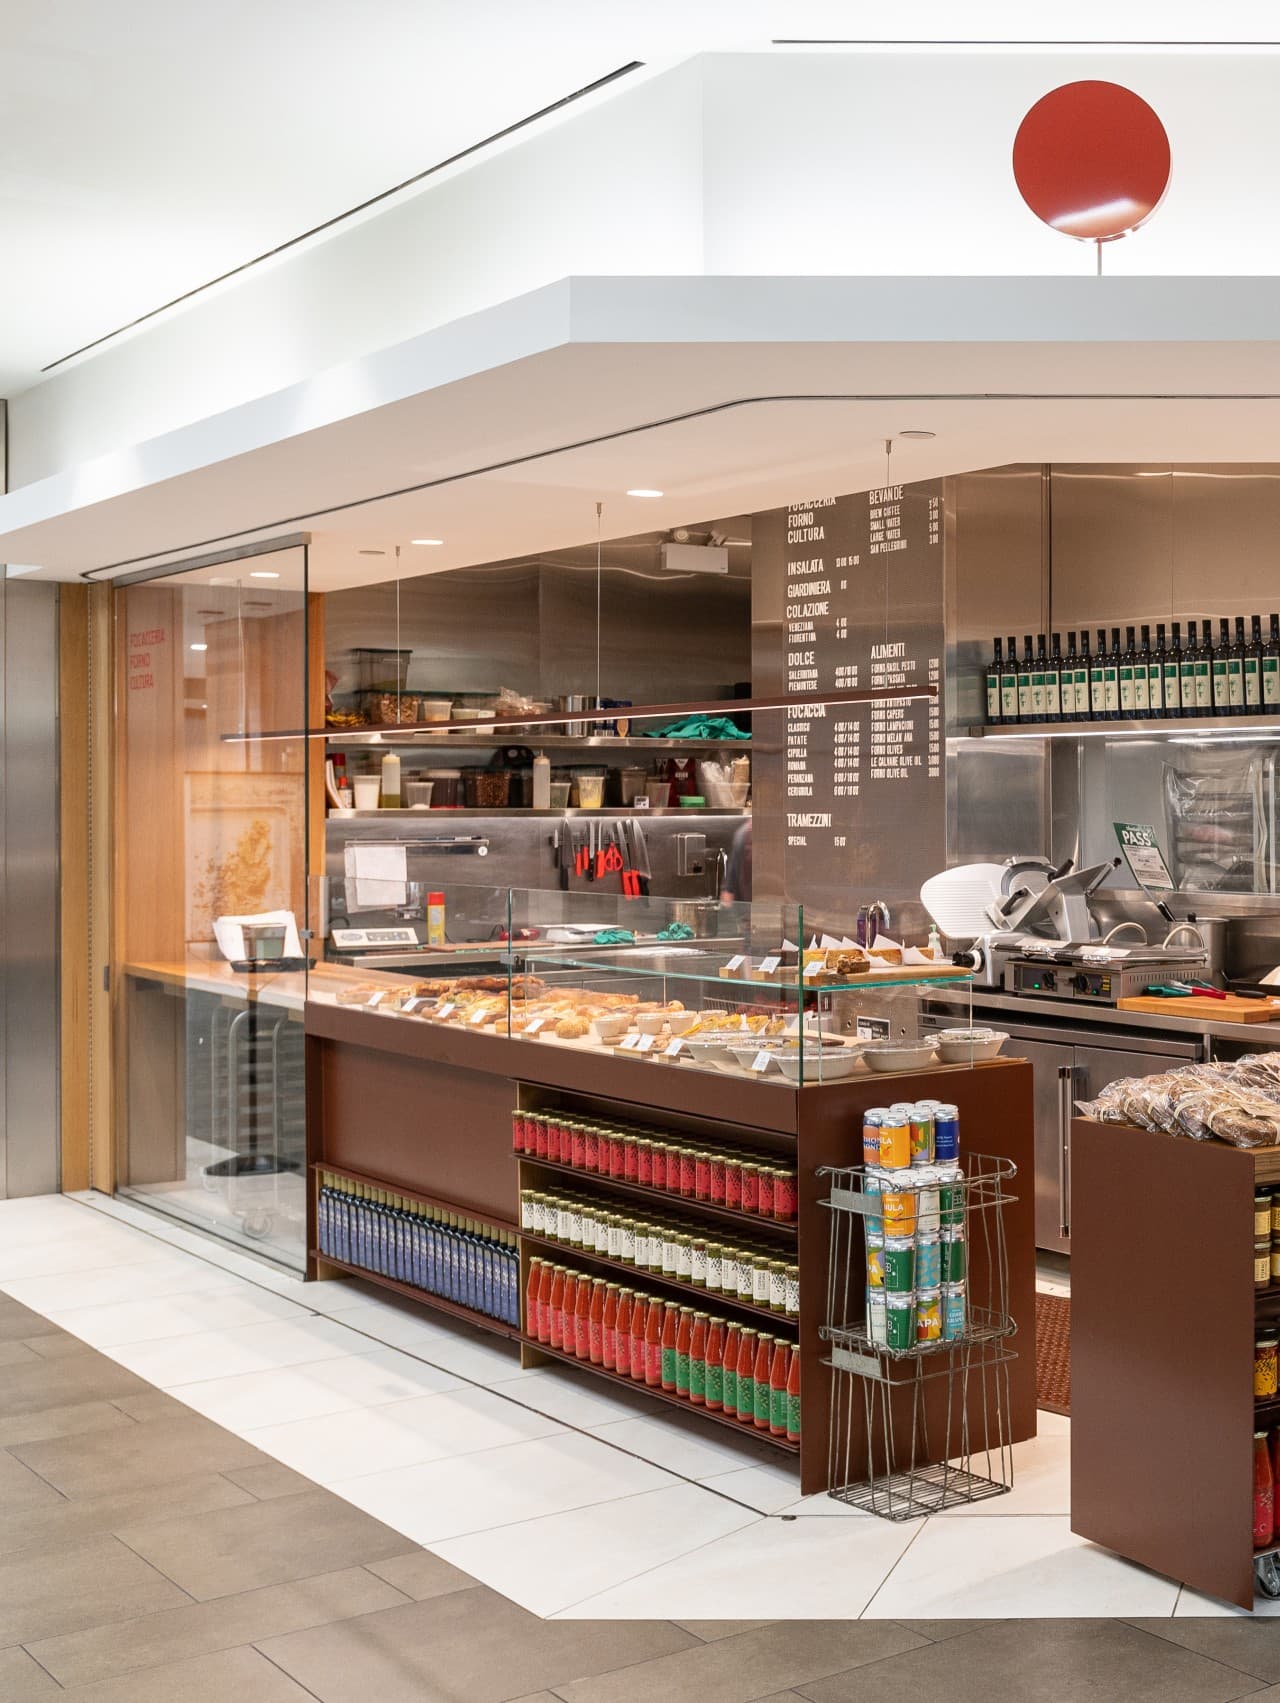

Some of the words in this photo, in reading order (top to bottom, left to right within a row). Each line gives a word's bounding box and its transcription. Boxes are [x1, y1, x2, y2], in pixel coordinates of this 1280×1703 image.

[870, 486, 904, 505] BEVANDE
[788, 512, 814, 528] FORNO
[887, 517, 900, 528] WATER
[788, 527, 824, 544] CULTURA
[887, 529, 901, 540] WATER
[788, 559, 824, 576] INSALATA
[788, 581, 831, 597] GIARDINIERA
[787, 602, 829, 618] COLAZIONE
[788, 651, 815, 666] DOLCE
[871, 643, 905, 660] ALIMENTI
[788, 704, 826, 718] FOCACCIA
[788, 735, 807, 745] PATATE
[871, 757, 879, 767] LE
[899, 756, 913, 766] OLIVE
[886, 768, 900, 778] OLIVE
[787, 813, 832, 828] TRAMEZZINI
[788, 836, 807, 846] SPECIAL
[1122, 830, 1152, 846] PASS
